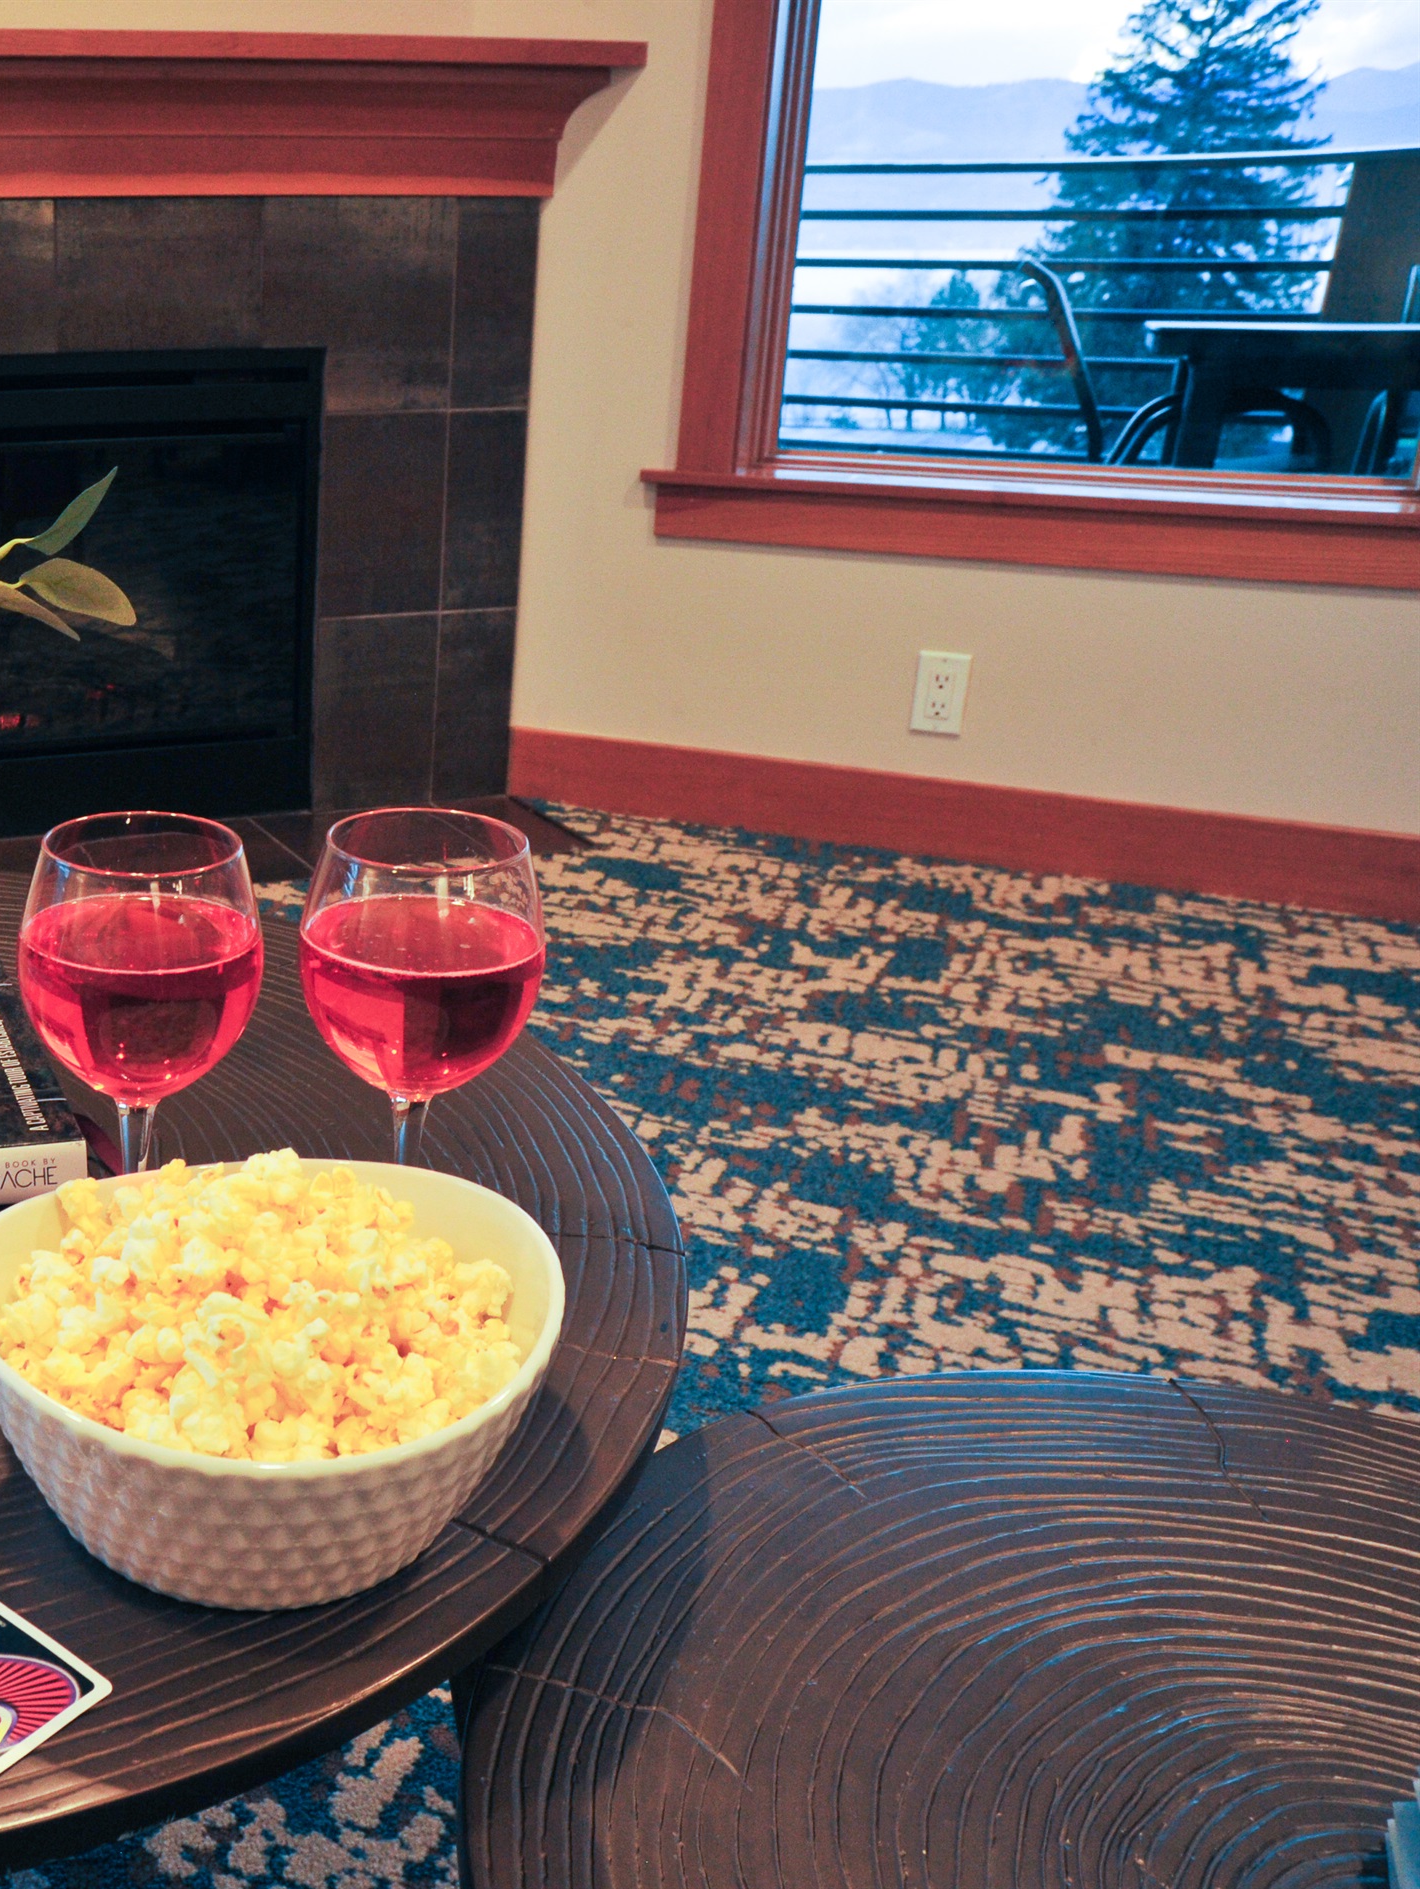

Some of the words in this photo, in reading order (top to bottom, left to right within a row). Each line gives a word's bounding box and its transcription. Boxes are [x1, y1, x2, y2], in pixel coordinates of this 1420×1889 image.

[4, 1066, 28, 1085] TOUR
[11, 1084, 47, 1125] CAPTIVATING
[5, 1159, 37, 1169] BOOK
[43, 1157, 56, 1166] BY
